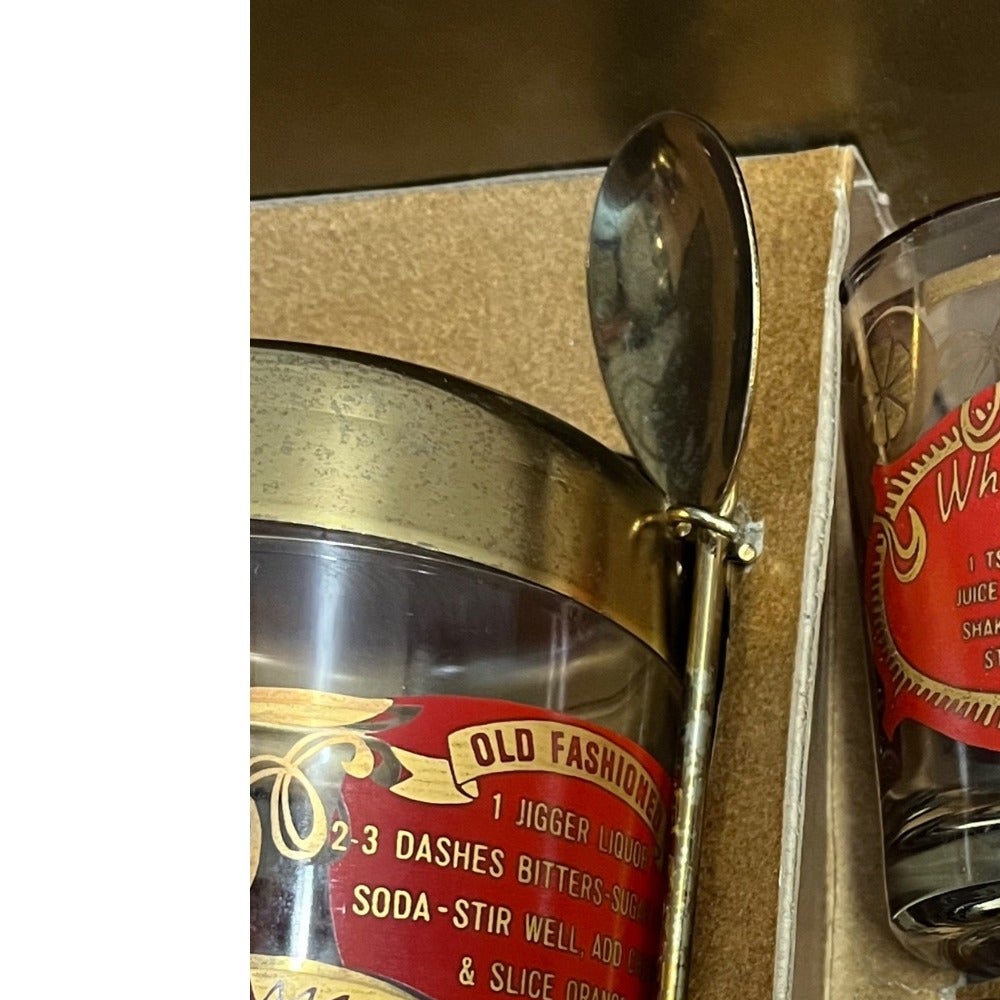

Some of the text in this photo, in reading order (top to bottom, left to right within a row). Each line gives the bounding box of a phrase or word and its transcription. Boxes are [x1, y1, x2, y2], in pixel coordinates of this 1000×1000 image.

[956, 579, 998, 608] JUICE
[470, 727, 536, 768] OLD
[491, 792, 502, 821] 1
[515, 797, 591, 846] JIGGER
[330, 819, 379, 857] 2-3
[395, 829, 505, 879] DASHES
[591, 932, 623, 968] ADD
[459, 956, 475, 988] &
